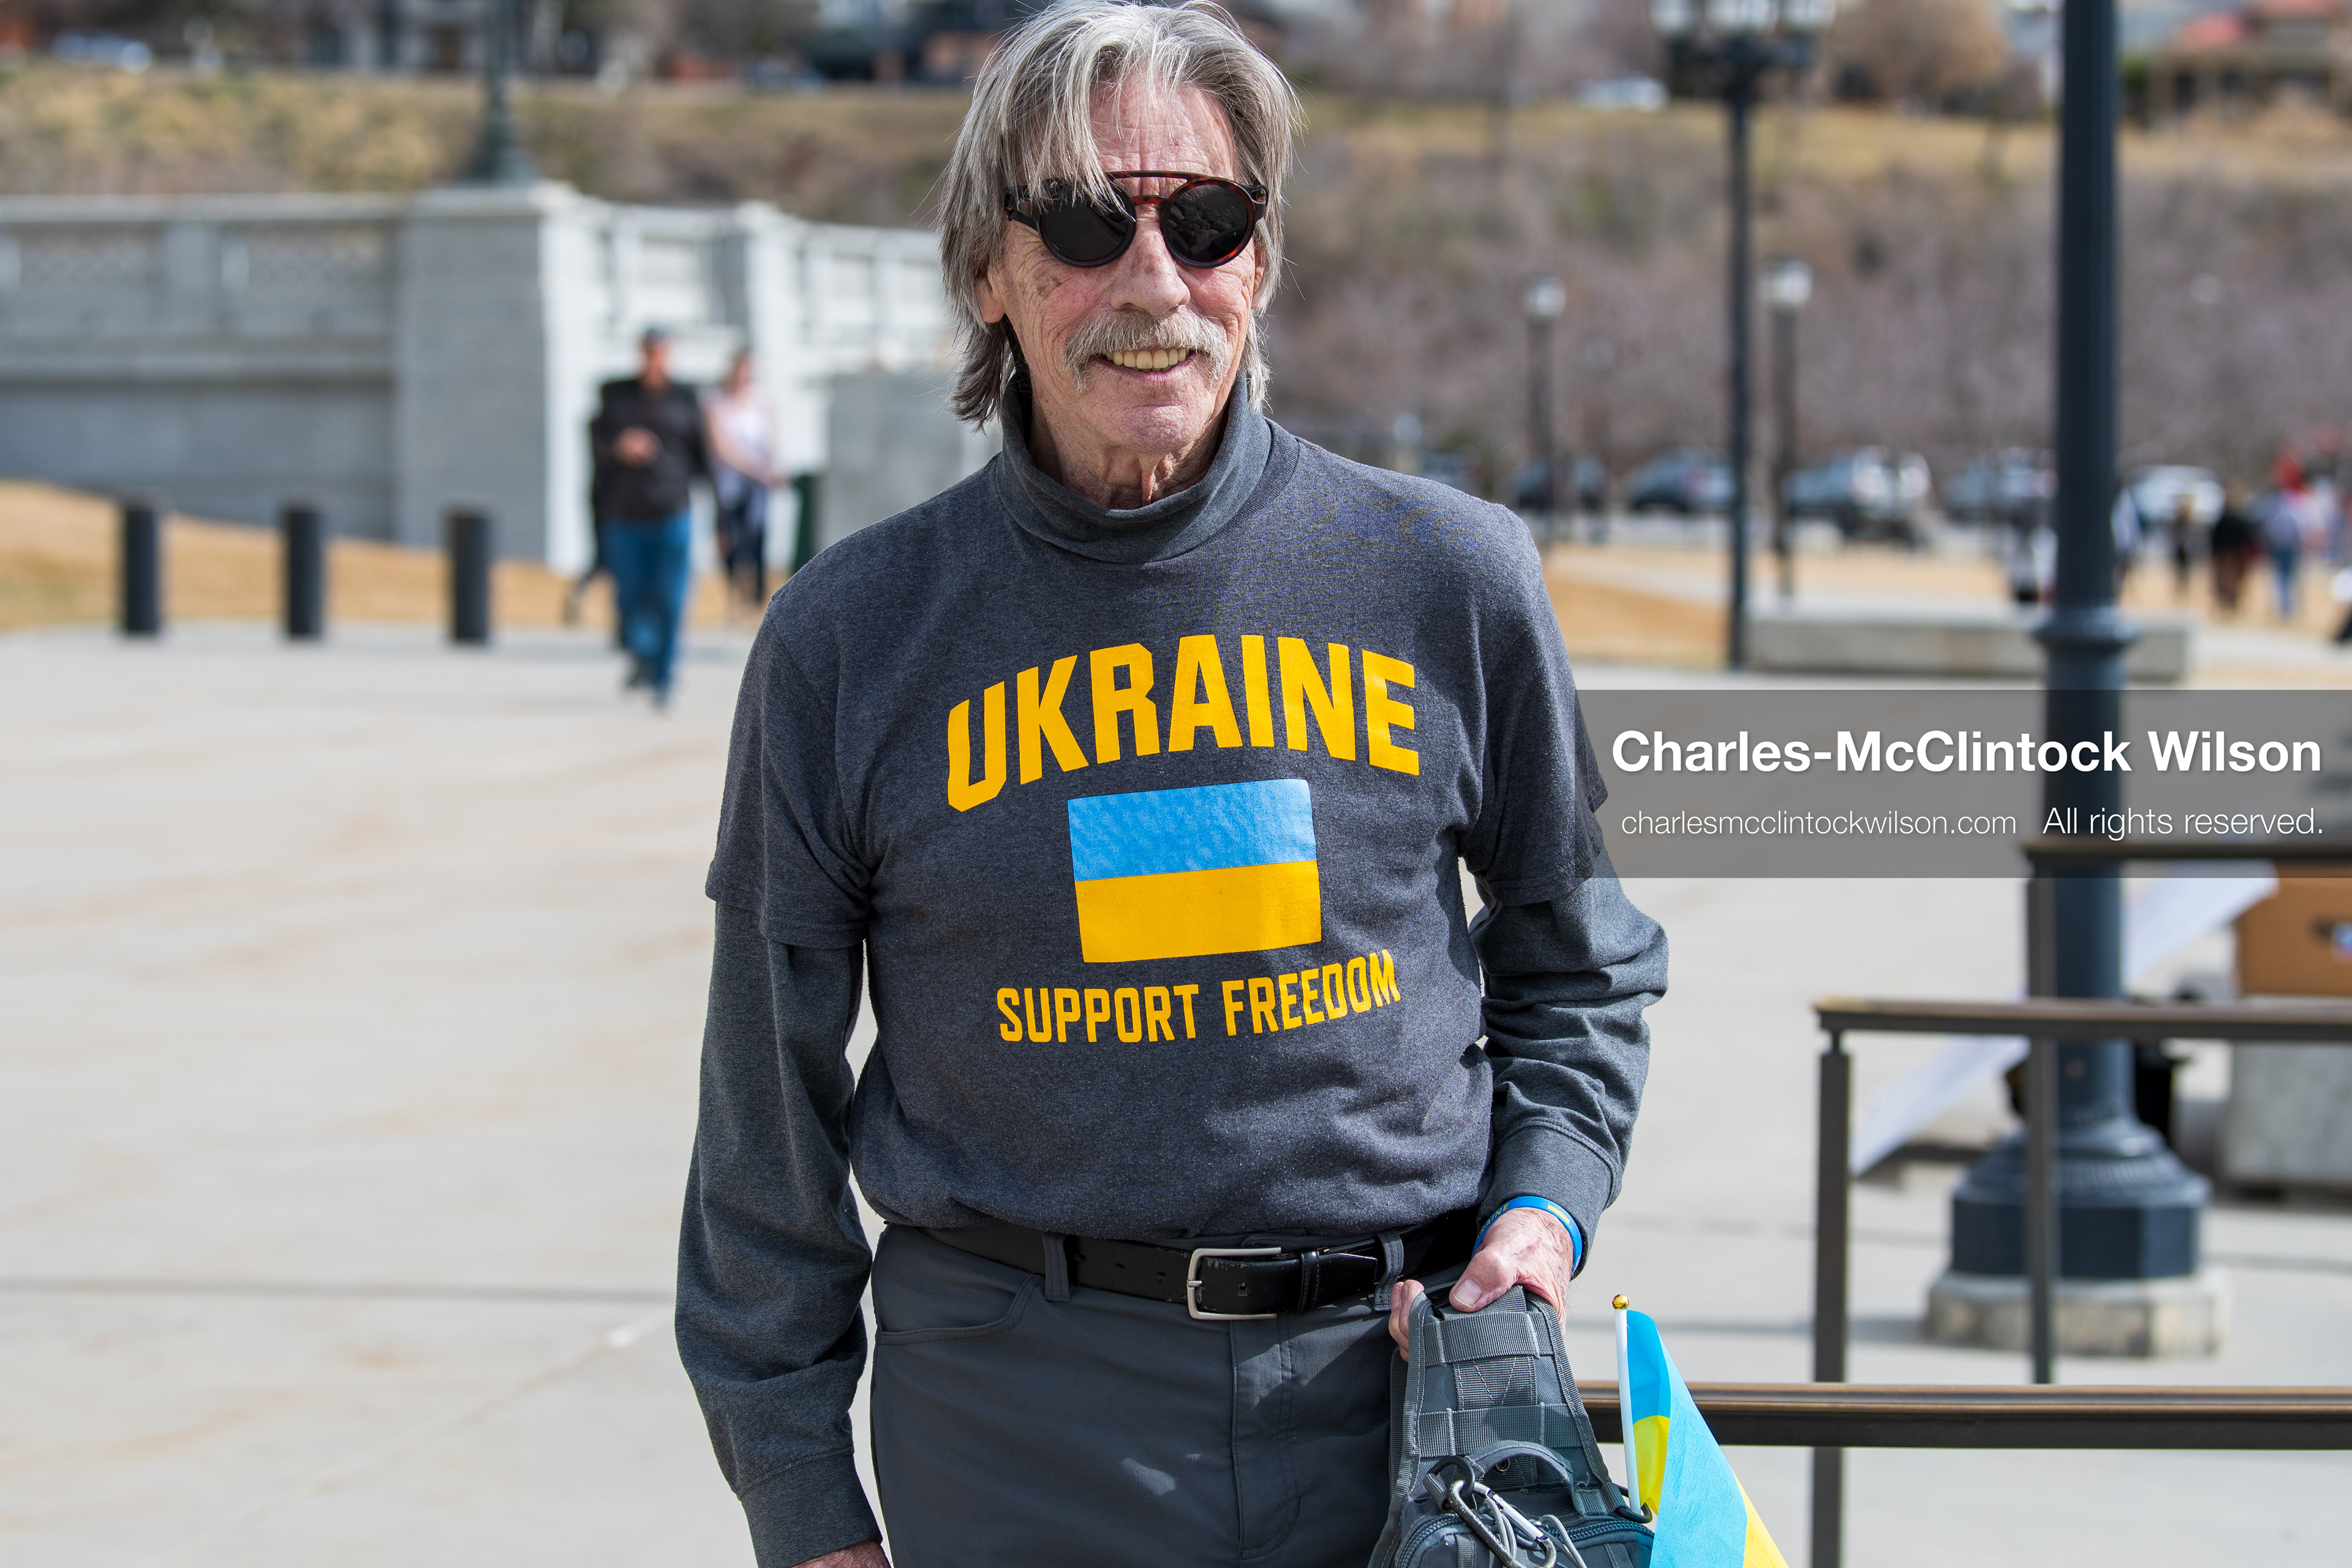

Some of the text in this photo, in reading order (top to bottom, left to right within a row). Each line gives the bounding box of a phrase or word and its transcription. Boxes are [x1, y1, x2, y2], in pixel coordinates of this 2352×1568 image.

[948, 634, 1419, 812] UKRAINE
[997, 949, 1401, 1043] SUPPORT FREEDOM
